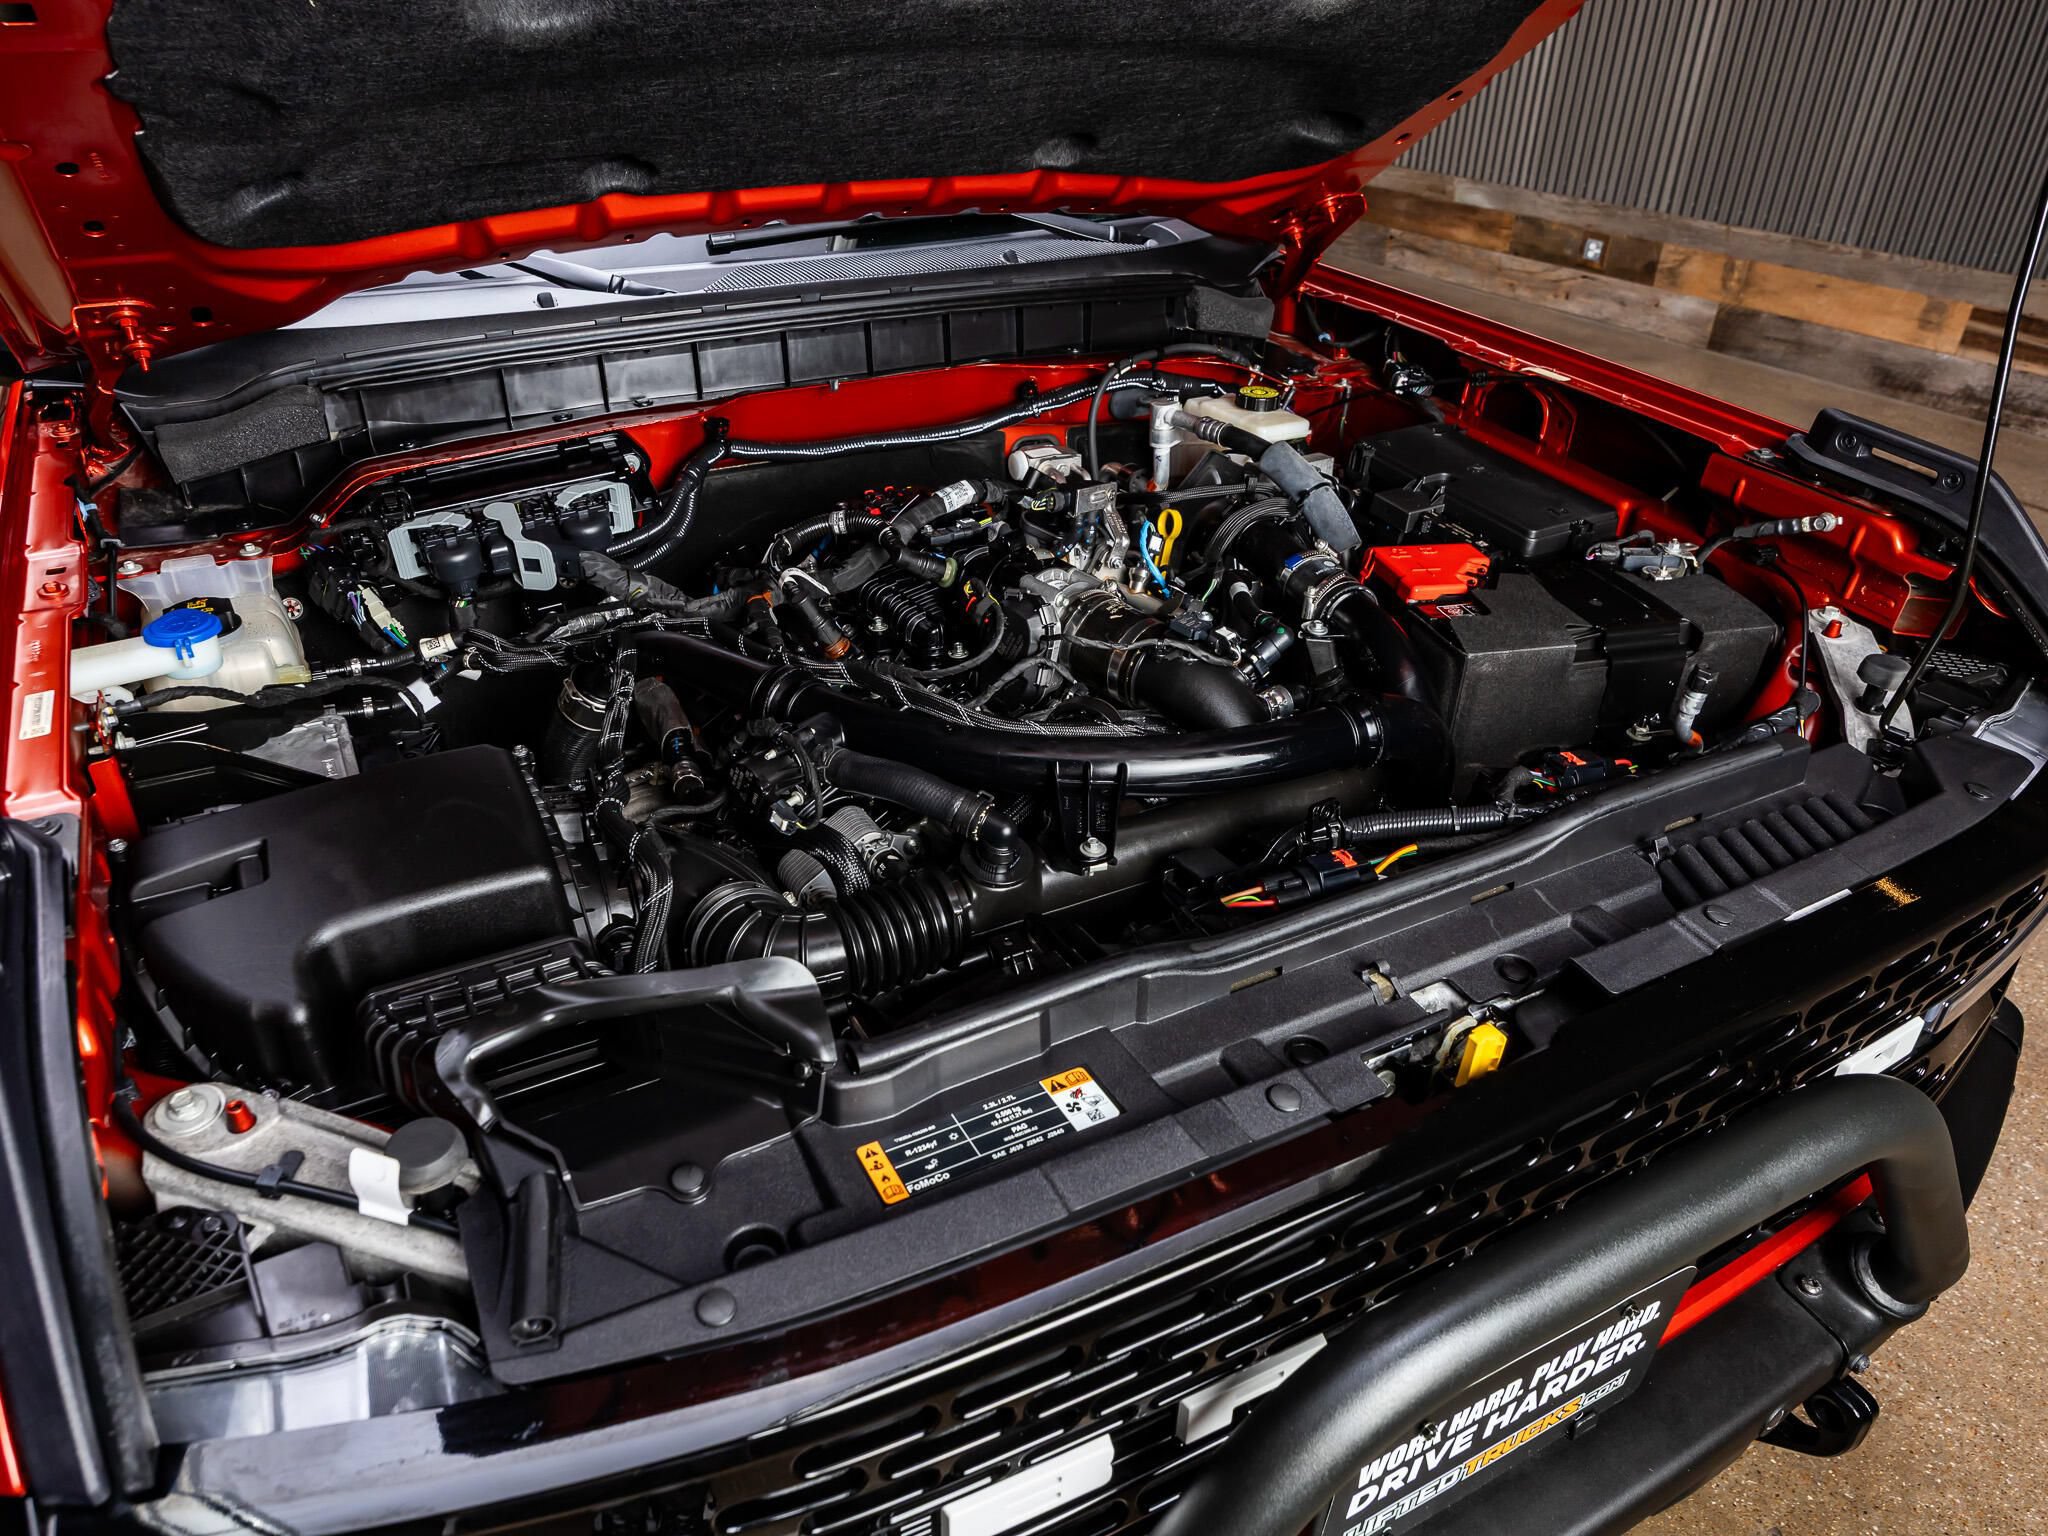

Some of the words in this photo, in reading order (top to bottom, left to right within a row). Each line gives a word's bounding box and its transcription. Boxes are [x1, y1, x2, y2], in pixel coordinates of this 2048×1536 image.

[1011, 1123, 1028, 1133] PAG
[906, 1172, 950, 1193] FoMoCo
[1447, 1377, 1523, 1437] HARD.
[1529, 1337, 1594, 1390] PLAY
[1346, 1423, 1479, 1520] DRIVE
[1482, 1332, 1647, 1440] HARDER.
